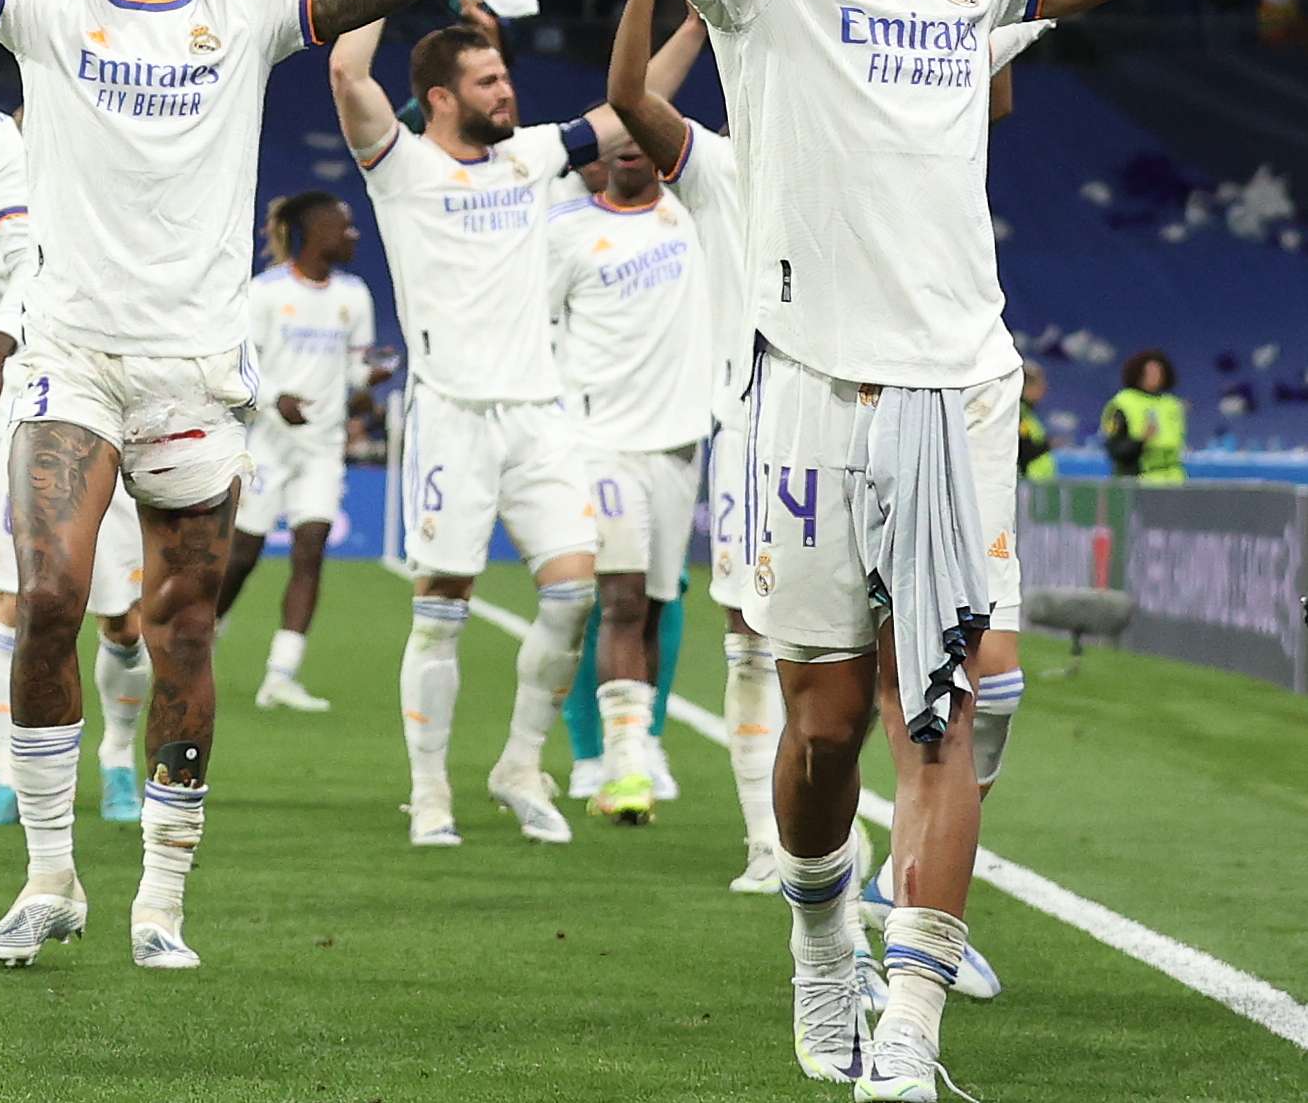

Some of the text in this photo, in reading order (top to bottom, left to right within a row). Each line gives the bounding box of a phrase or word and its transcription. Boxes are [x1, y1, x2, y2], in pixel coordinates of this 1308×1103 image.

[840, 7, 977, 52] Emirates
[78, 49, 219, 89] Emirates
[868, 54, 973, 88] FLY BETTER
[95, 89, 201, 117] FLY BETTER
[28, 376, 50, 417] 3
[423, 465, 444, 512] 6
[761, 463, 818, 548] 14
